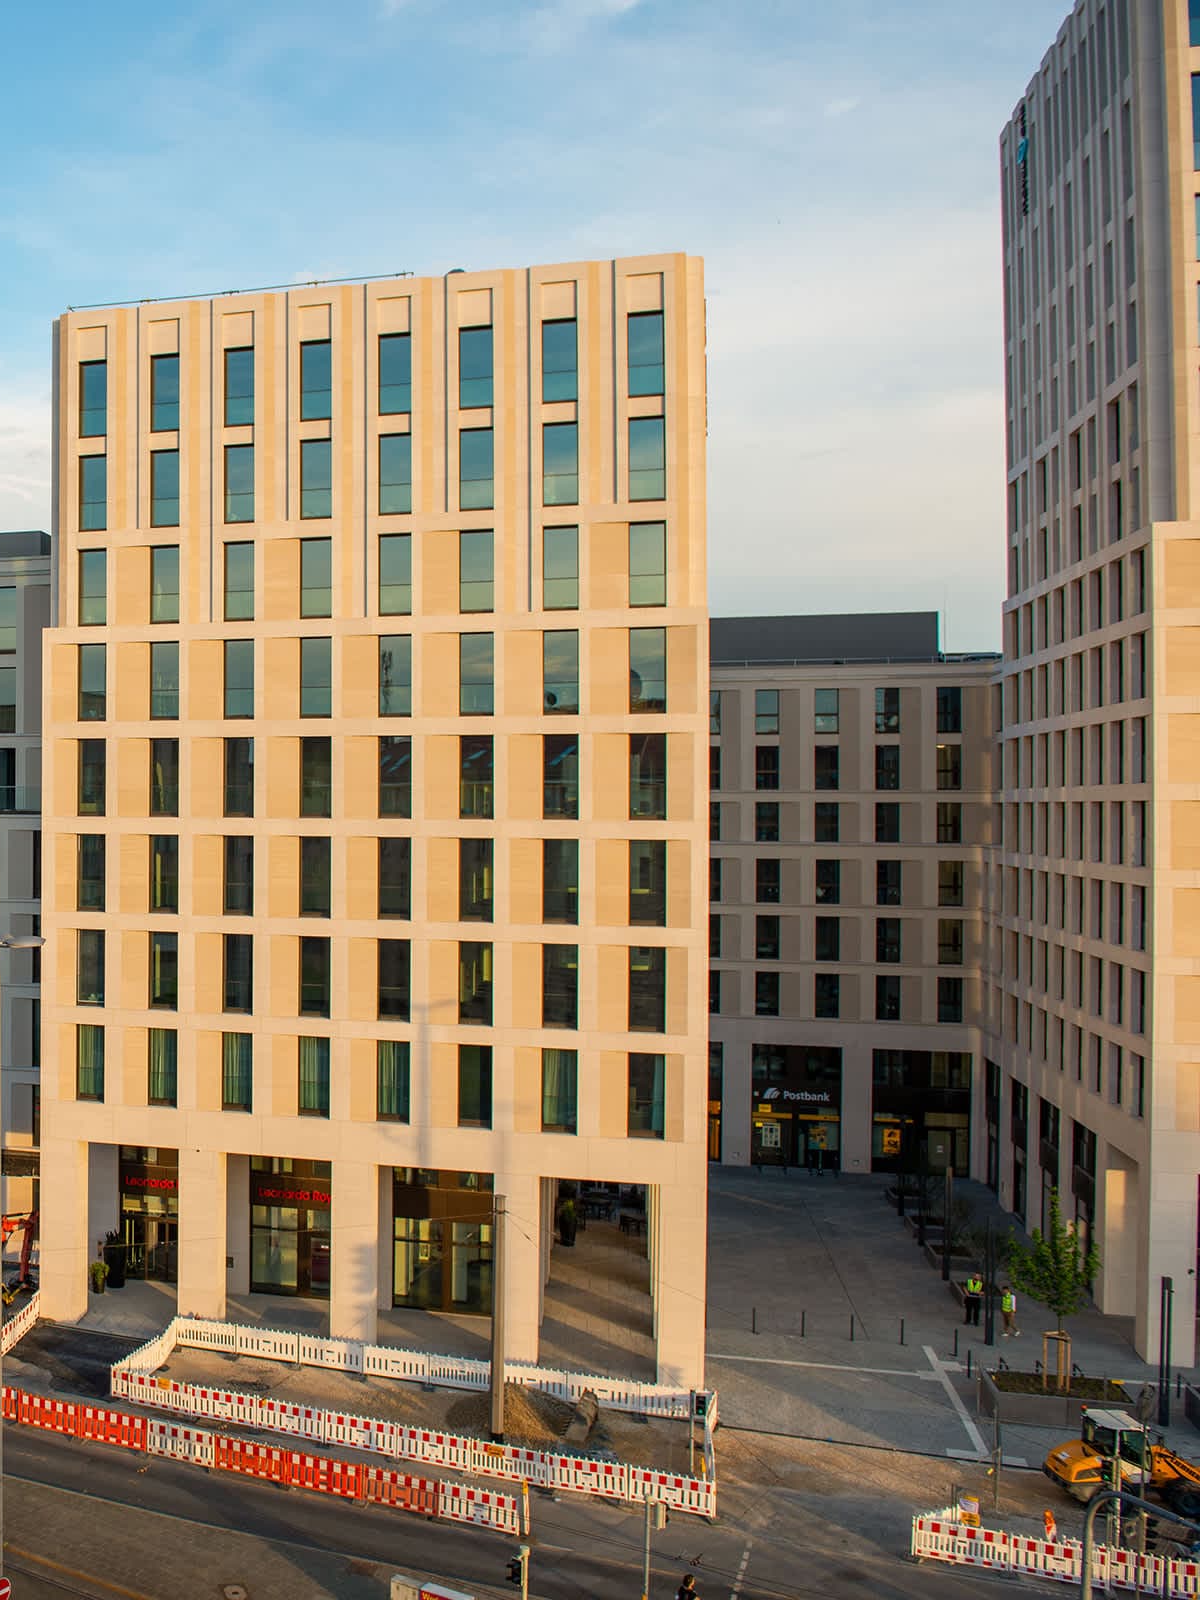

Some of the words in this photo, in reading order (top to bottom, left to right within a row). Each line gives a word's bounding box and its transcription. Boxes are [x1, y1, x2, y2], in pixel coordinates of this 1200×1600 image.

[783, 1090, 831, 1102] Postbank
[125, 1175, 175, 1190] Leonardo
[258, 1186, 310, 1201] Leonardo
